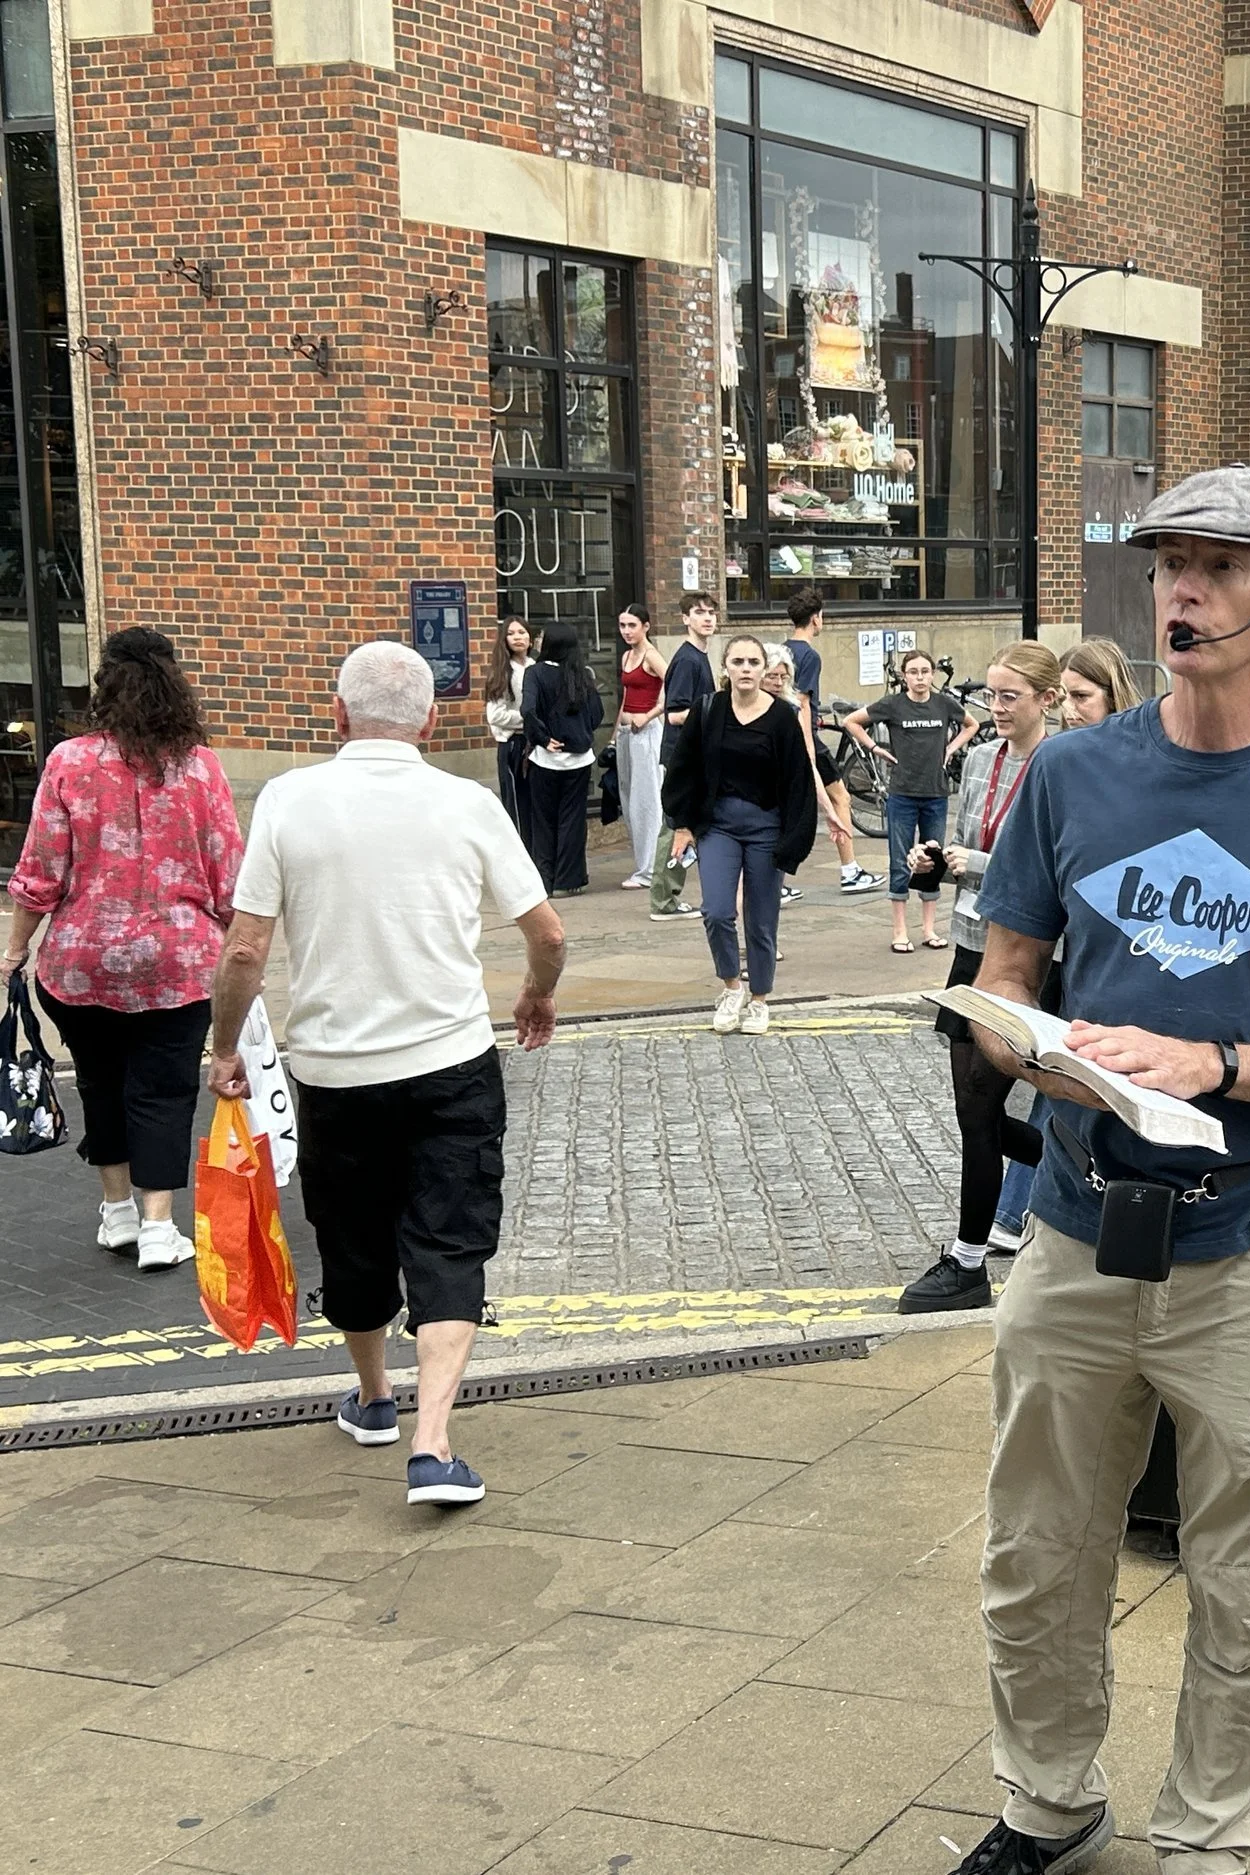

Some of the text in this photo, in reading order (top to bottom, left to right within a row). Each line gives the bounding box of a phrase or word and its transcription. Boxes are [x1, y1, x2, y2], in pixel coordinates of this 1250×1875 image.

[876, 475, 914, 504] Home
[886, 633, 895, 651] P
[1117, 866, 1164, 923] Lee
[1129, 925, 1238, 972] Originals
